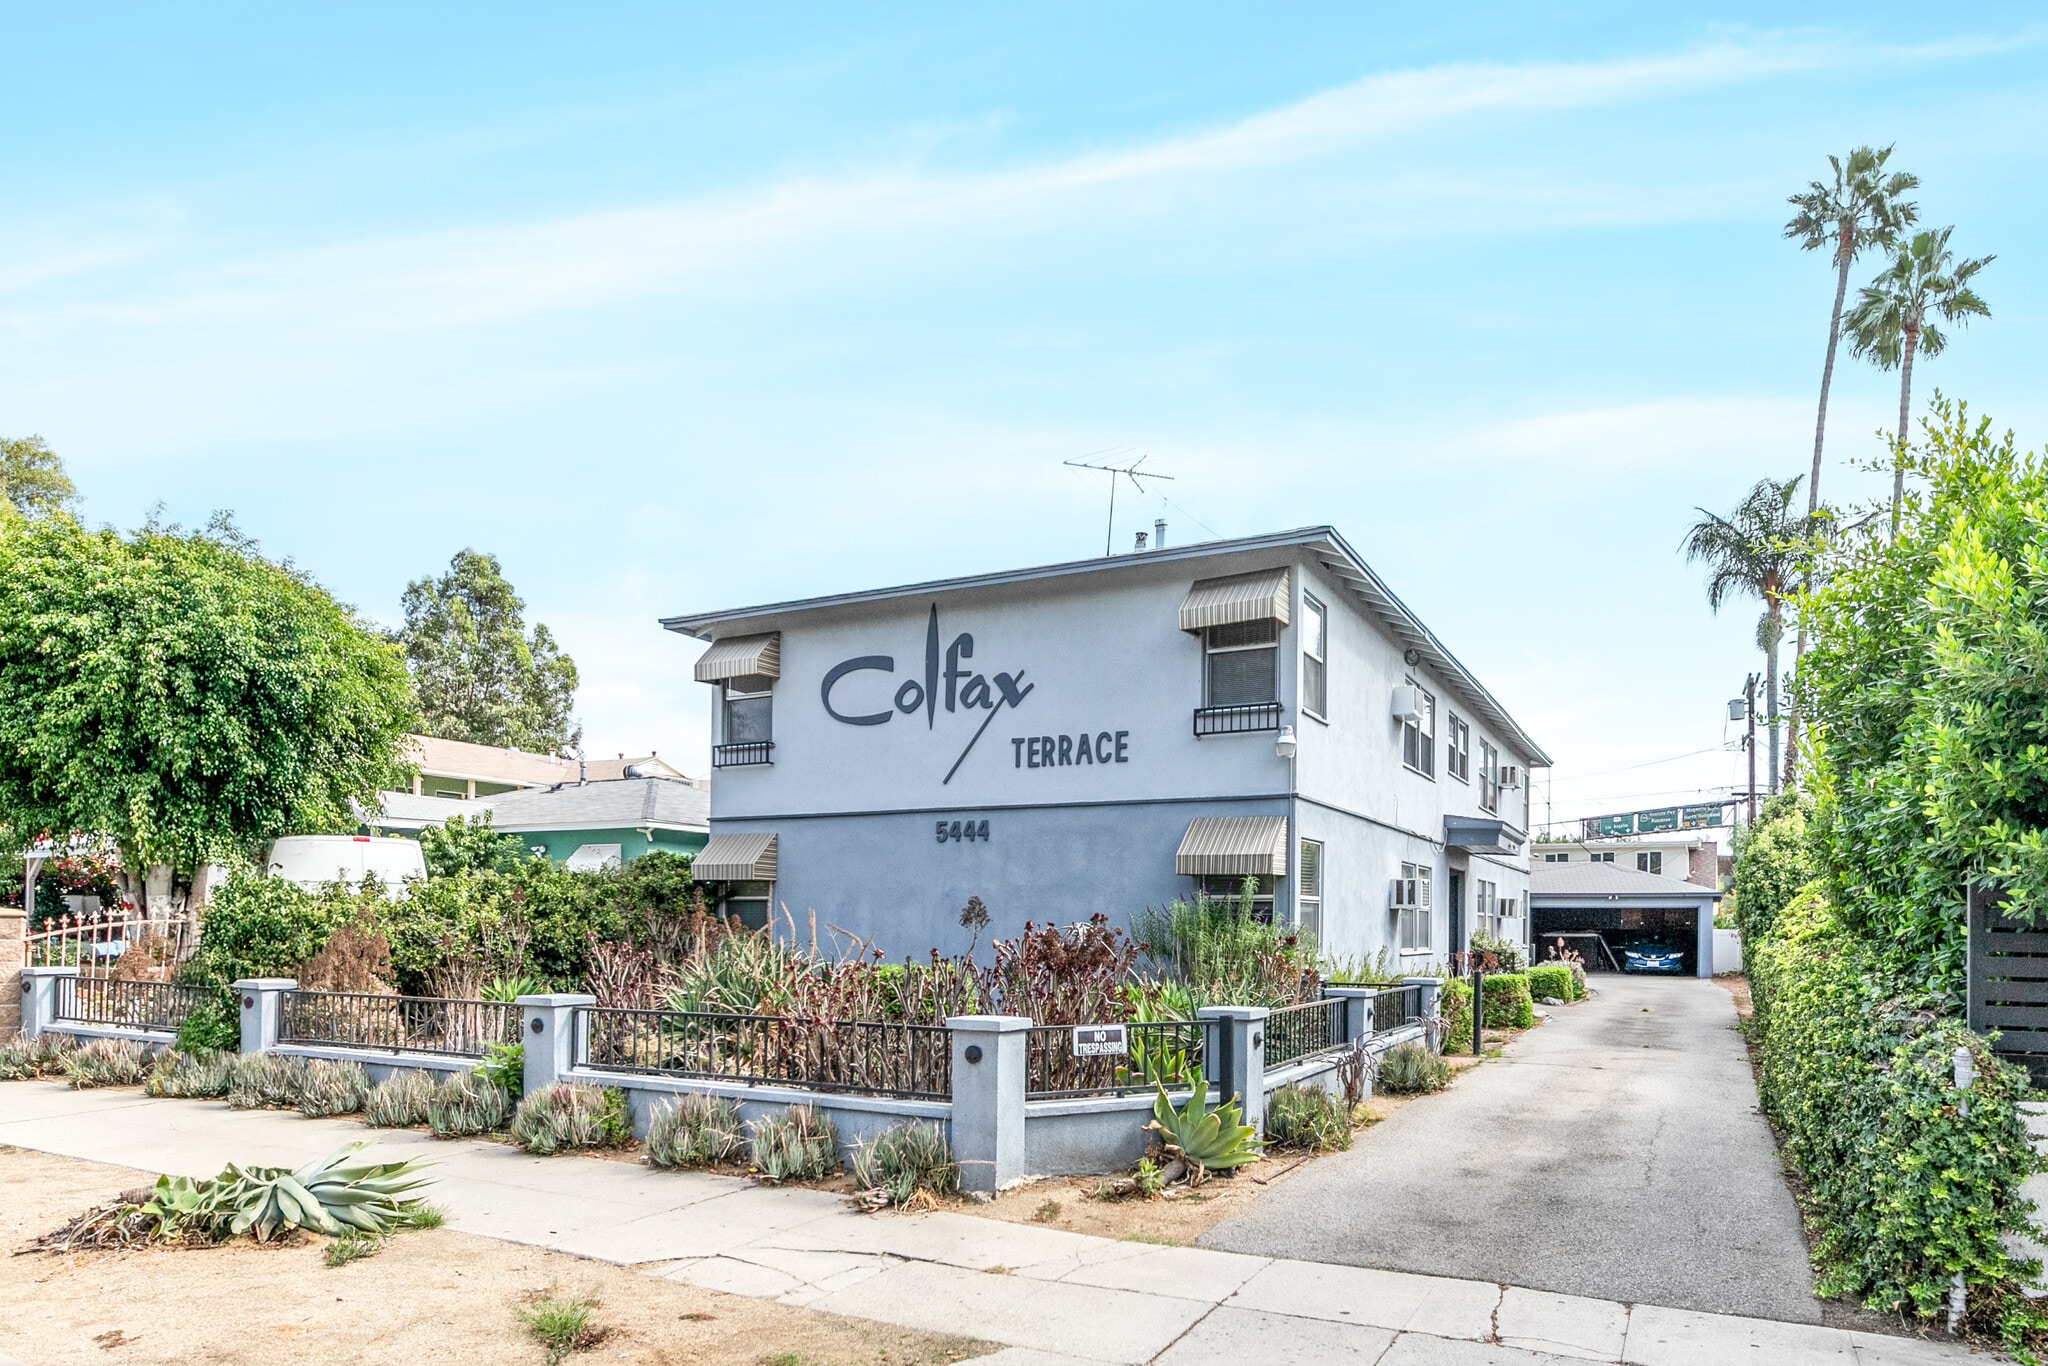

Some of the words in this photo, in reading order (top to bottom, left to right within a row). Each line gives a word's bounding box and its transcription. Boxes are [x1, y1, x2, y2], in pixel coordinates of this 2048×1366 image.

[821, 602, 1034, 784] Colfax
[1011, 730, 1129, 768] TERRACE
[935, 819, 990, 843] 5444
[1078, 1041, 1122, 1055] TRESPASSING
[1094, 1031, 1107, 1042] NO
